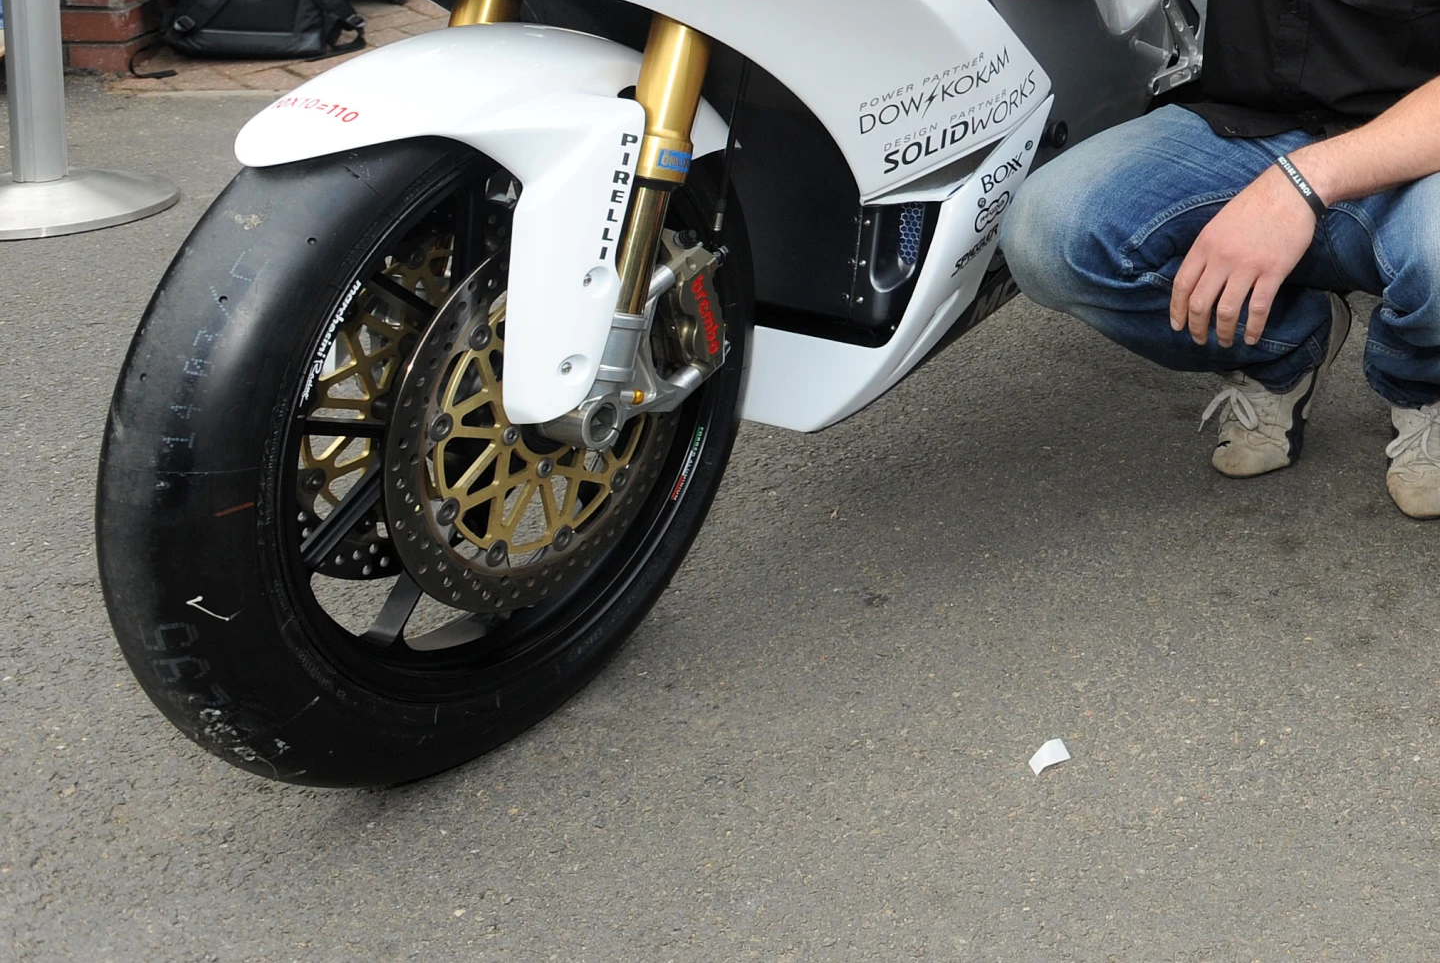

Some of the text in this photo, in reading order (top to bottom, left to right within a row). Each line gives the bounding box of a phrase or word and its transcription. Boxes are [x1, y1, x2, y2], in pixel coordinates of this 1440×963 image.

[858, 44, 1010, 135] DOW KOKAM
[859, 51, 985, 112] POWER PARTNER
[883, 89, 1008, 153] DESIGN PARTNER
[883, 69, 1036, 175] SOLIDWORKS
[598, 132, 639, 261] PIRELLI
[1292, 173, 1302, 184] TT
[1298, 181, 1312, 197] IOM
[317, 279, 362, 358] marchesini
[691, 274, 719, 355] brembo
